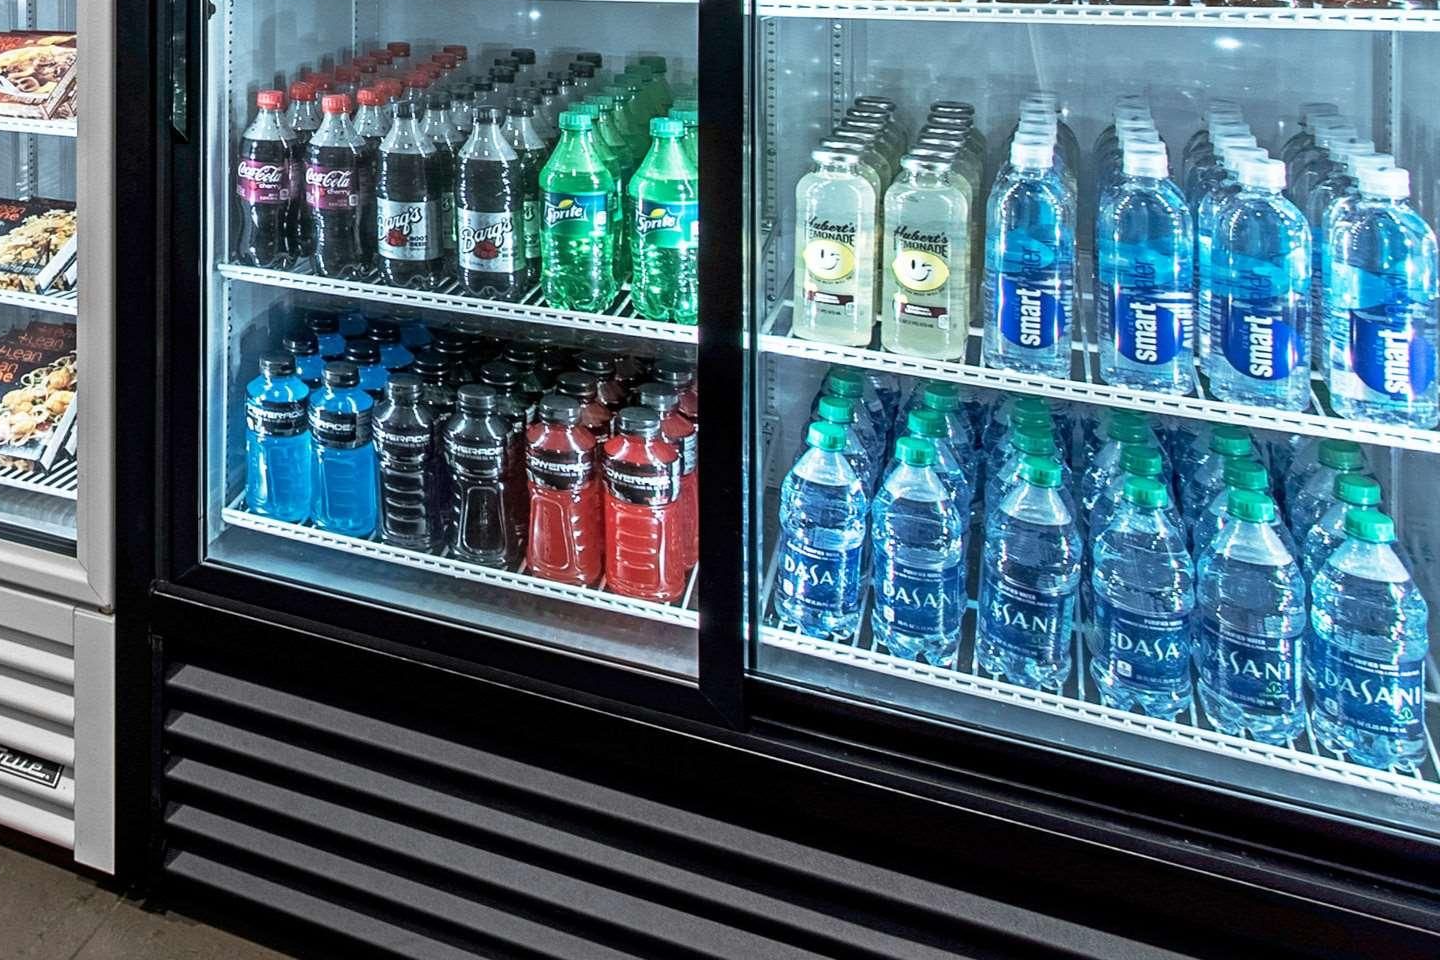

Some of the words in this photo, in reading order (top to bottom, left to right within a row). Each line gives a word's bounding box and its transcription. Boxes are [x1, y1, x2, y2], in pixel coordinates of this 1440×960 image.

[238, 162, 283, 183] Coca-Cola
[306, 168, 352, 187] Coca-Cola
[378, 207, 422, 240] Barq's
[547, 205, 584, 221] Sprite
[639, 214, 676, 230] Sprite
[461, 218, 512, 253] Barq's
[894, 226, 948, 244] Hubert's
[1016, 288, 1042, 346] smart
[1130, 301, 1158, 362] smart
[1244, 315, 1273, 377] smart
[1378, 329, 1411, 394] smart
[1324, 667, 1420, 705] DASANI
